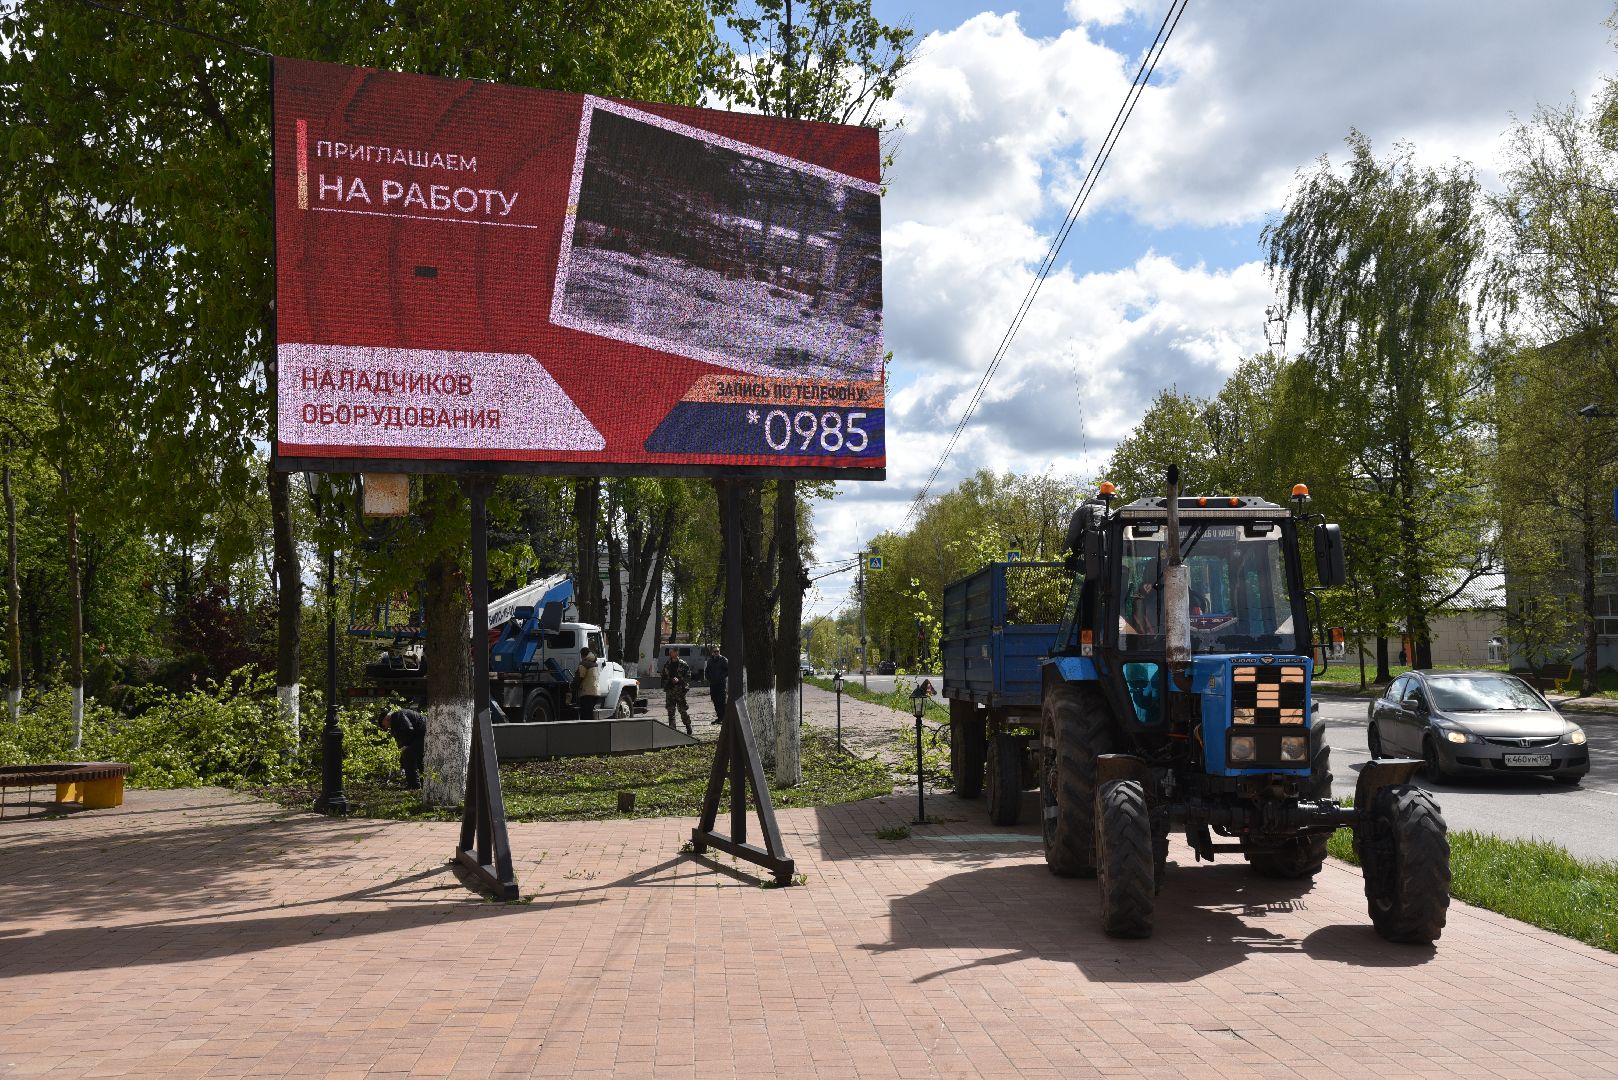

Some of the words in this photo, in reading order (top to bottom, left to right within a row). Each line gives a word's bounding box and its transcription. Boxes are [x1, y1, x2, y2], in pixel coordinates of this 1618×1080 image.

[316, 140, 478, 173] ПРИГЛАШАЕМ
[318, 173, 372, 205] НА
[381, 178, 519, 216] РАБОТУ
[302, 367, 473, 396] НАЛАДЧИКОВ
[716, 381, 769, 397] ЗАПИСЬ
[773, 384, 792, 399] ПО
[302, 403, 501, 430] ОБОРУДОВАНИЯ
